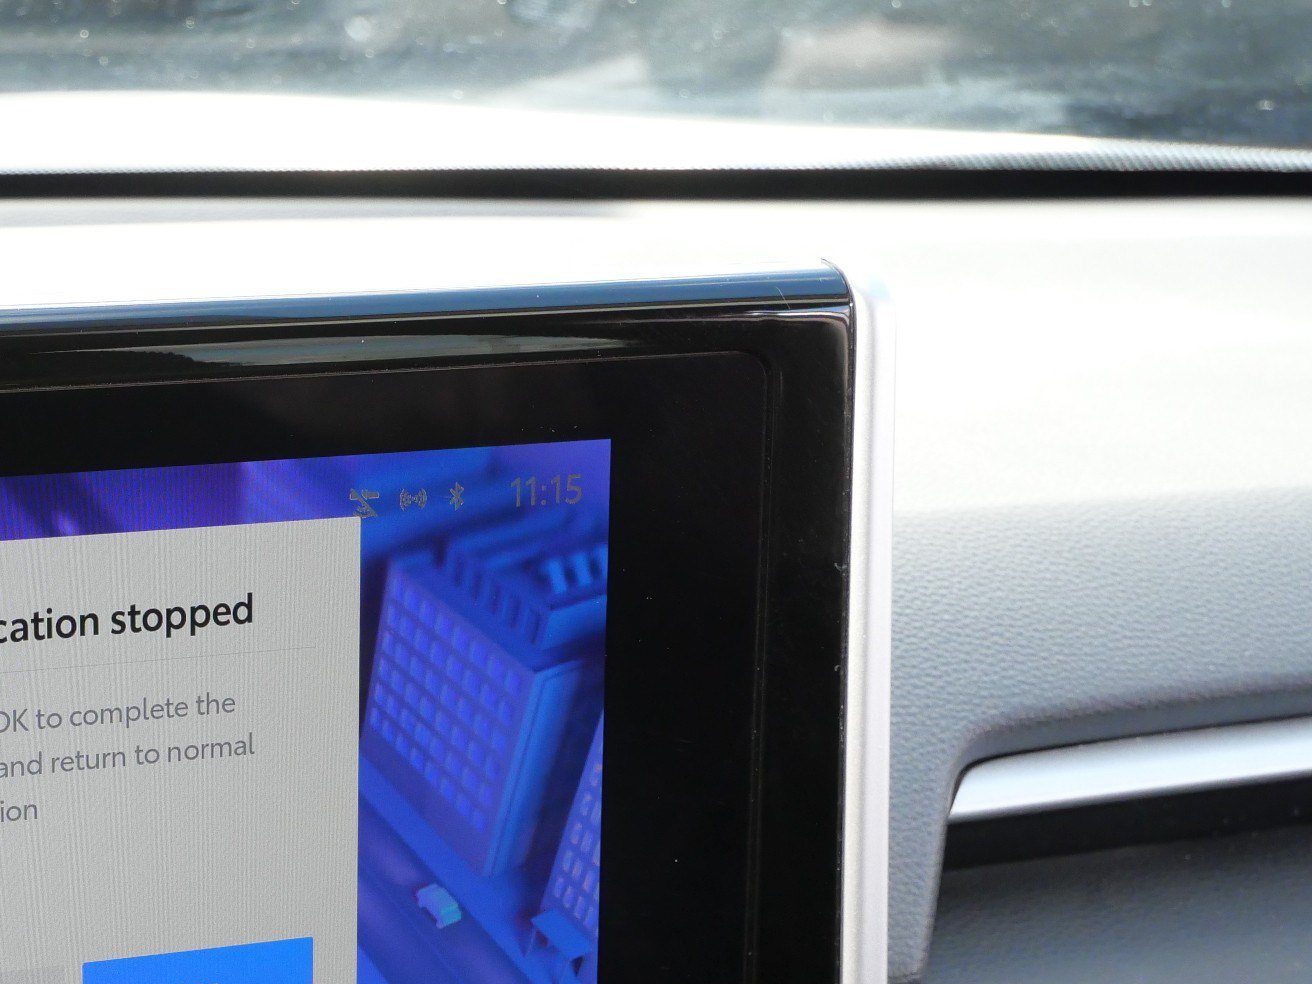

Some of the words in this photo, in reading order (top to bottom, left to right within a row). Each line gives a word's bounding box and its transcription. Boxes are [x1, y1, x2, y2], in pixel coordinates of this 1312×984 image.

[510, 473, 584, 508] 11:15
[110, 592, 253, 639] stopped
[35, 709, 63, 730] to
[69, 697, 189, 729] complete
[196, 691, 237, 716] the
[51, 750, 127, 774] return
[134, 745, 160, 766] to
[167, 731, 256, 763] normal
